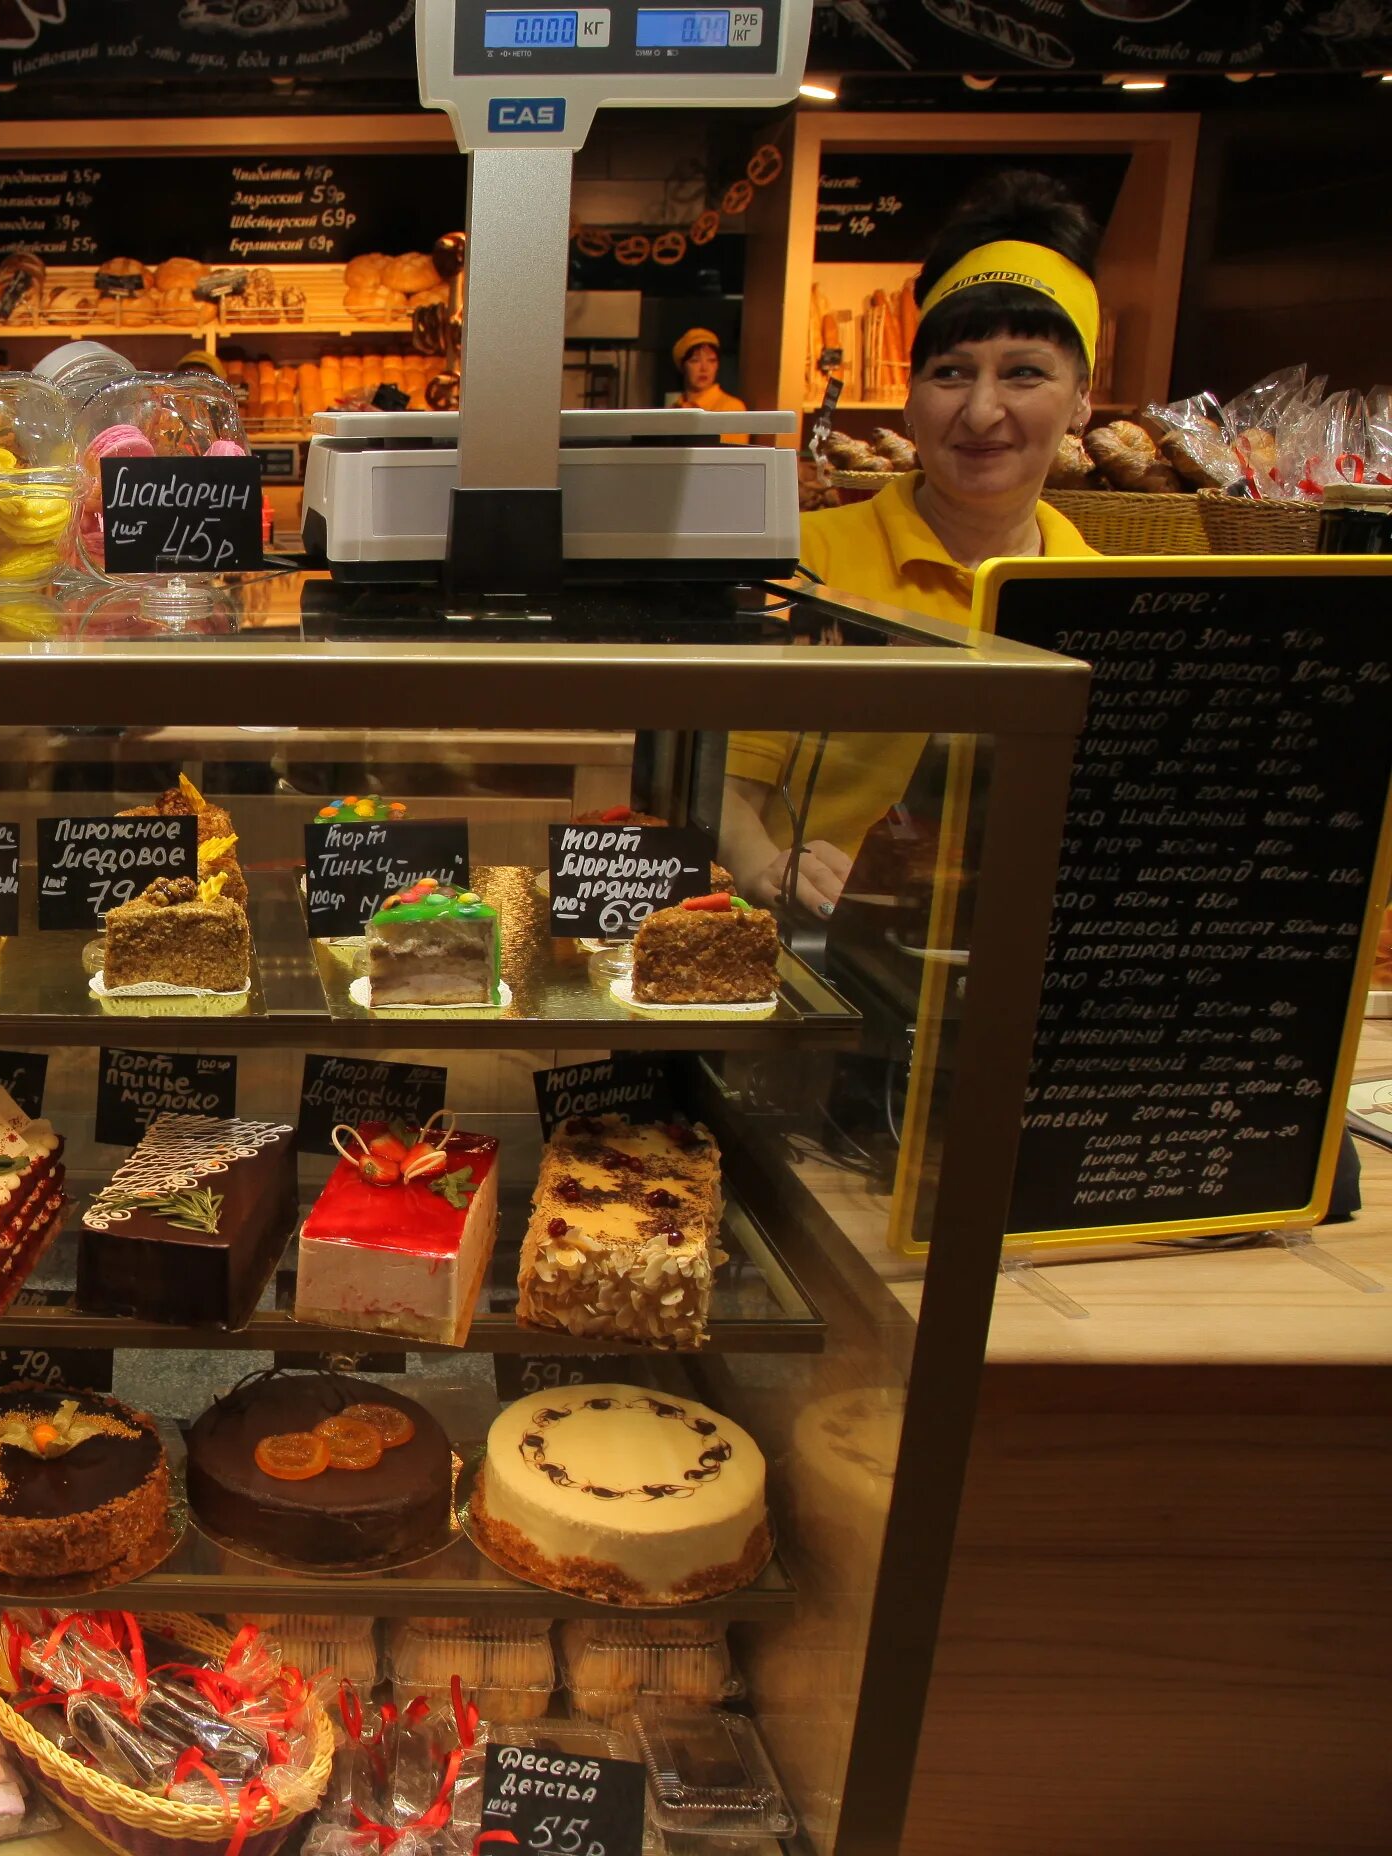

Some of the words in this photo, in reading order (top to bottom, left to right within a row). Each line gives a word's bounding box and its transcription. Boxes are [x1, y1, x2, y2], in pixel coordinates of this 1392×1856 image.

[734, 13, 758, 27] РУБ
[514, 18, 575, 44] 0.000
[584, 21, 604, 35] КГ
[733, 29, 751, 42] /КГ
[512, 50, 532, 58] НЕТТО
[498, 106, 555, 125] CAS
[321, 207, 356, 230] 69р
